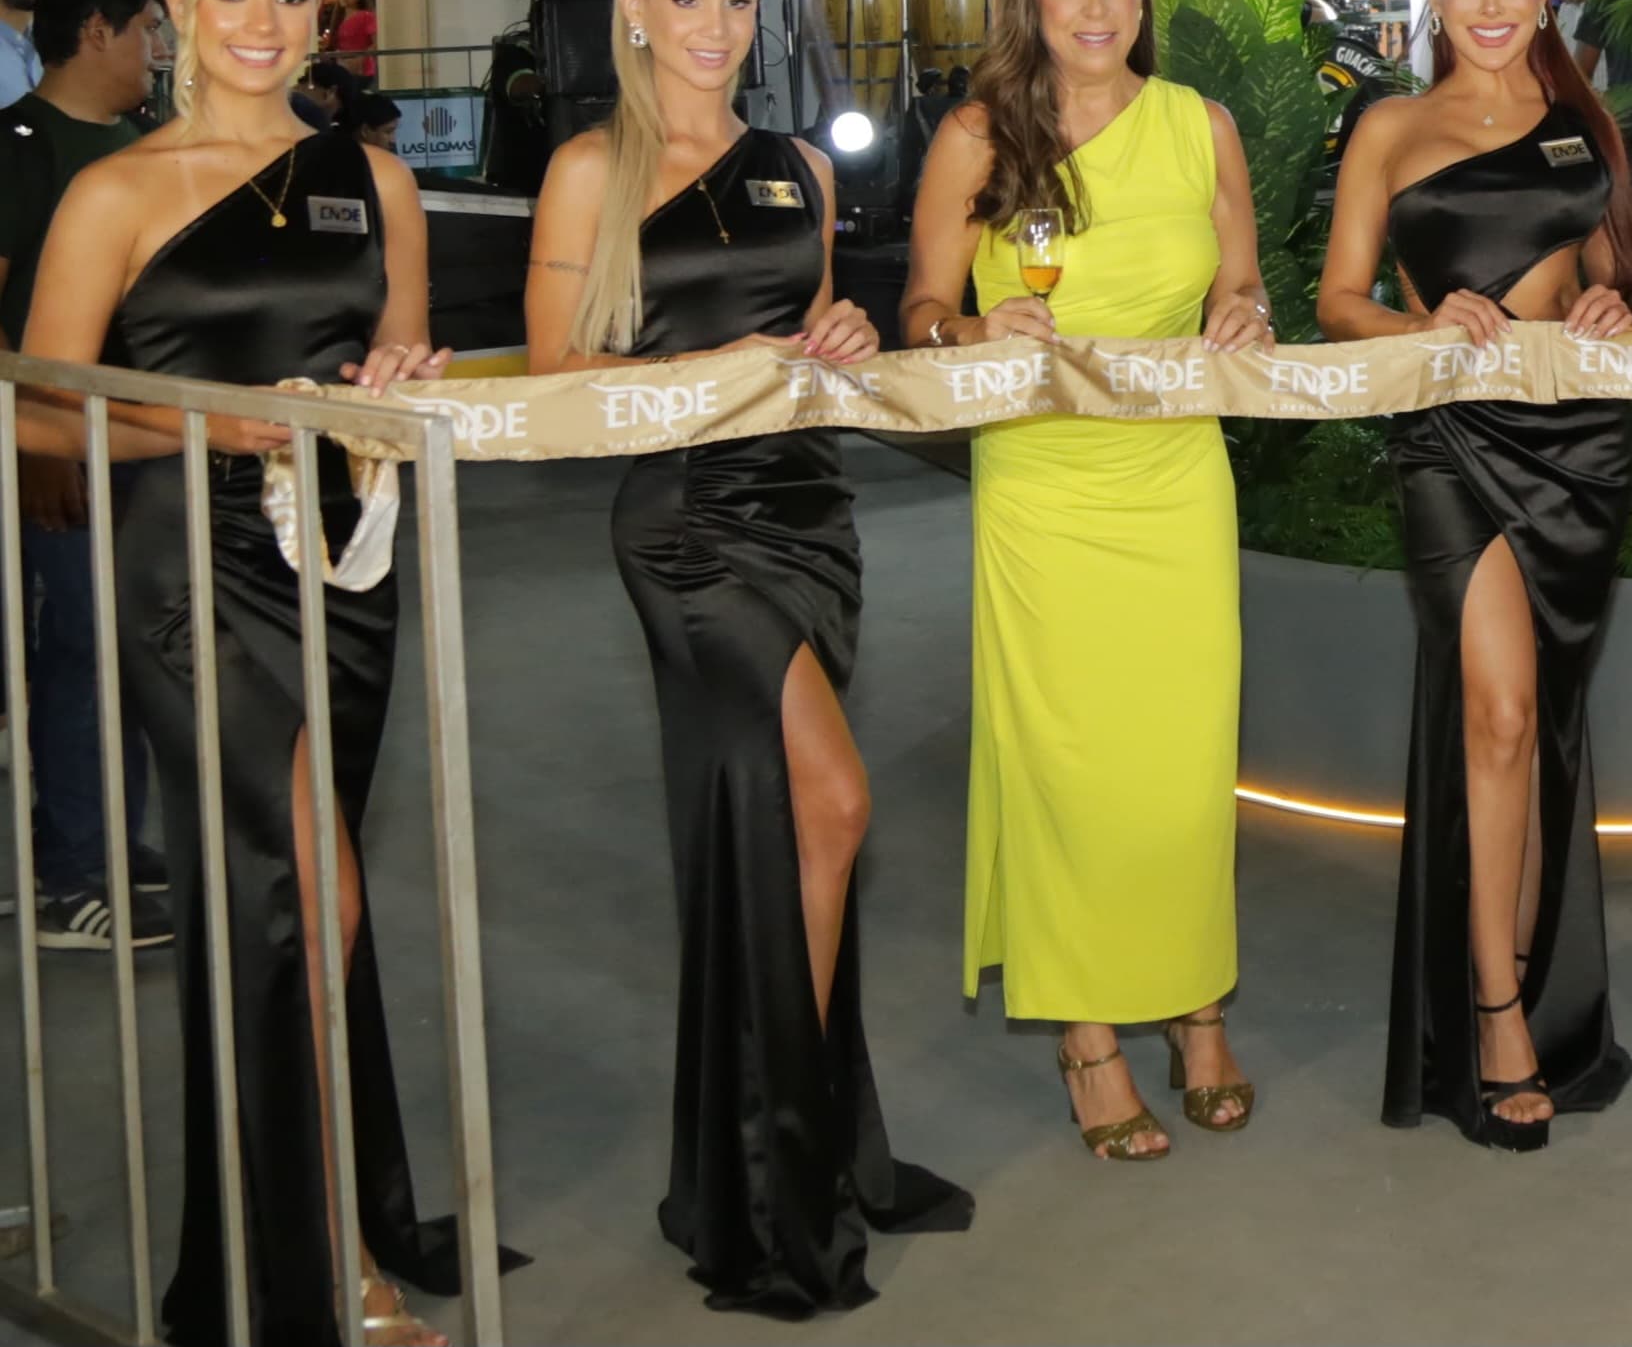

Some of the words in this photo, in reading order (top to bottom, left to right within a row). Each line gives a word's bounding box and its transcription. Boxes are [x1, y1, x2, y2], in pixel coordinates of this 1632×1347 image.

[402, 142, 427, 155] LAS
[430, 140, 477, 154] LOMAS
[950, 352, 1052, 403] ENDE
[1107, 358, 1205, 393] ENDE
[1270, 363, 1369, 396] ENDE
[1431, 340, 1522, 382] ENDE
[413, 402, 529, 441] NDE
[606, 380, 718, 429] ENDE
